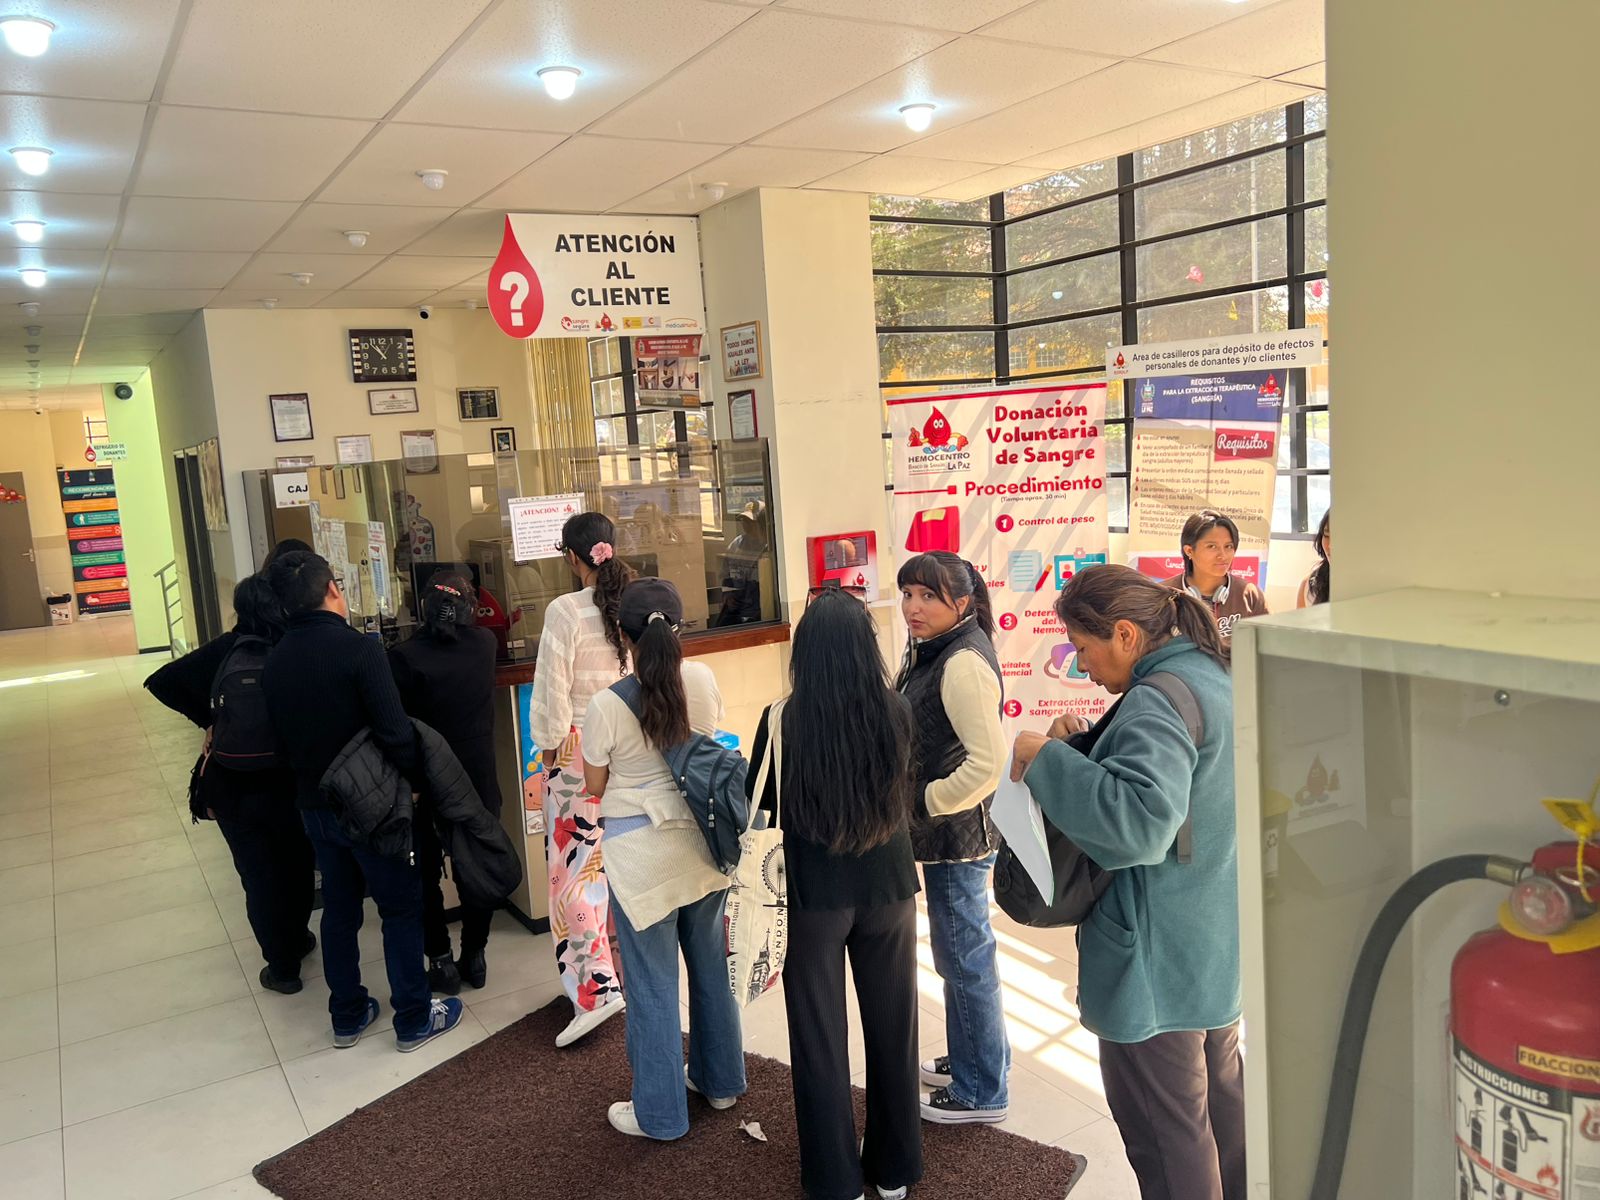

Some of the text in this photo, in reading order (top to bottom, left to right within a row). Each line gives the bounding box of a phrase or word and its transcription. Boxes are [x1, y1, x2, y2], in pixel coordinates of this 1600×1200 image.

[555, 230, 675, 253] ATENCIÓN
[606, 261, 635, 280] AL
[571, 287, 670, 307] CLIENTE
[1151, 352, 1160, 360] de
[1162, 350, 1200, 359] casilleros
[1202, 347, 1220, 358] para
[1222, 343, 1261, 355] depósito
[1264, 342, 1276, 351] de
[1278, 340, 1314, 350] efectos
[1146, 352, 1296, 372] personales de donantes y/o clientes
[1190, 378, 1226, 386] REQUISITOS
[995, 399, 1088, 422] Donación
[986, 420, 1098, 444] Voluntaria
[1217, 433, 1268, 456] Requisitos
[908, 452, 970, 463] HEMOCENTRO
[995, 447, 1095, 468] de Sangre
[288, 484, 308, 493] CAJ
[965, 475, 1103, 496] Procedimiento
[520, 507, 559, 517] ¡ATENCIÓN!
[1001, 516, 1094, 528] 1 Control de peso
[986, 580, 1005, 588] ales
[1004, 616, 1012, 627] 3
[1009, 698, 1104, 714] 5 Extracción de
[1030, 708, 1064, 717] sangre
[1520, 1050, 1600, 1077] FRACCION
[1460, 1050, 1549, 1106] INSTRUCCIONES
